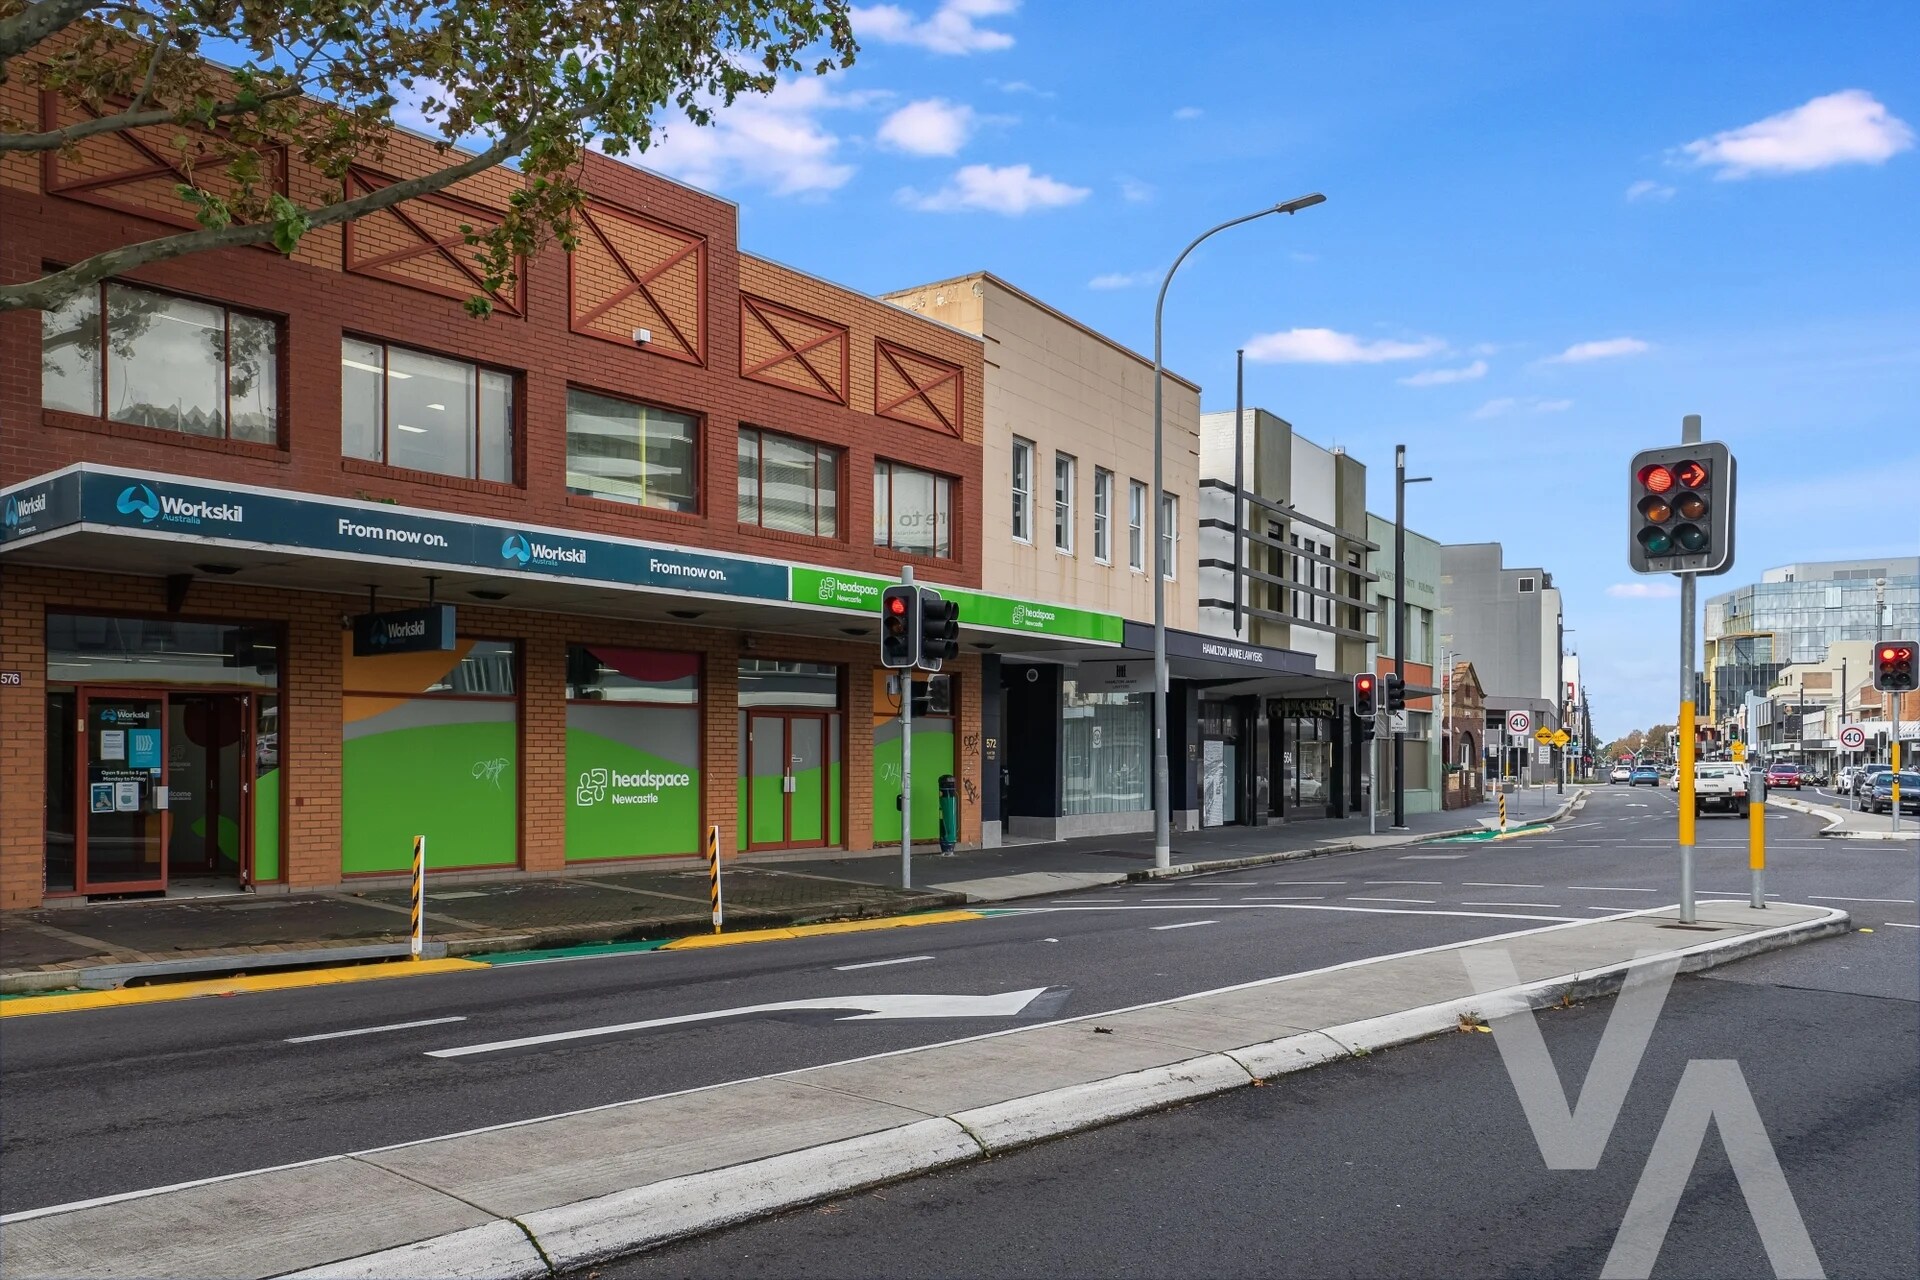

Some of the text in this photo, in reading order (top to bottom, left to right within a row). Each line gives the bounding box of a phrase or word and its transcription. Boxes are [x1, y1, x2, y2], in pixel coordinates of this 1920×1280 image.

[18, 493, 46, 517] Workskil
[160, 495, 243, 523] Workskil
[162, 513, 201, 525] Australia
[338, 518, 448, 548] From now on.
[530, 542, 587, 564] Workskil
[532, 557, 558, 567] Australia
[650, 558, 727, 581] From now on.
[836, 579, 879, 597] headspace
[836, 594, 862, 605] Newcastle
[1025, 606, 1056, 621] headspace
[387, 619, 425, 639] Workskil
[1202, 642, 1228, 657] HAMILTON
[1242, 650, 1263, 663] LAWYERS
[0, 672, 20, 685] 576
[117, 710, 150, 719] Workskil
[1512, 718, 1526, 727] 40
[986, 738, 997, 748] 572
[1843, 732, 1861, 743] 40
[611, 769, 690, 791] headspace
[611, 793, 659, 805] Newcastle
